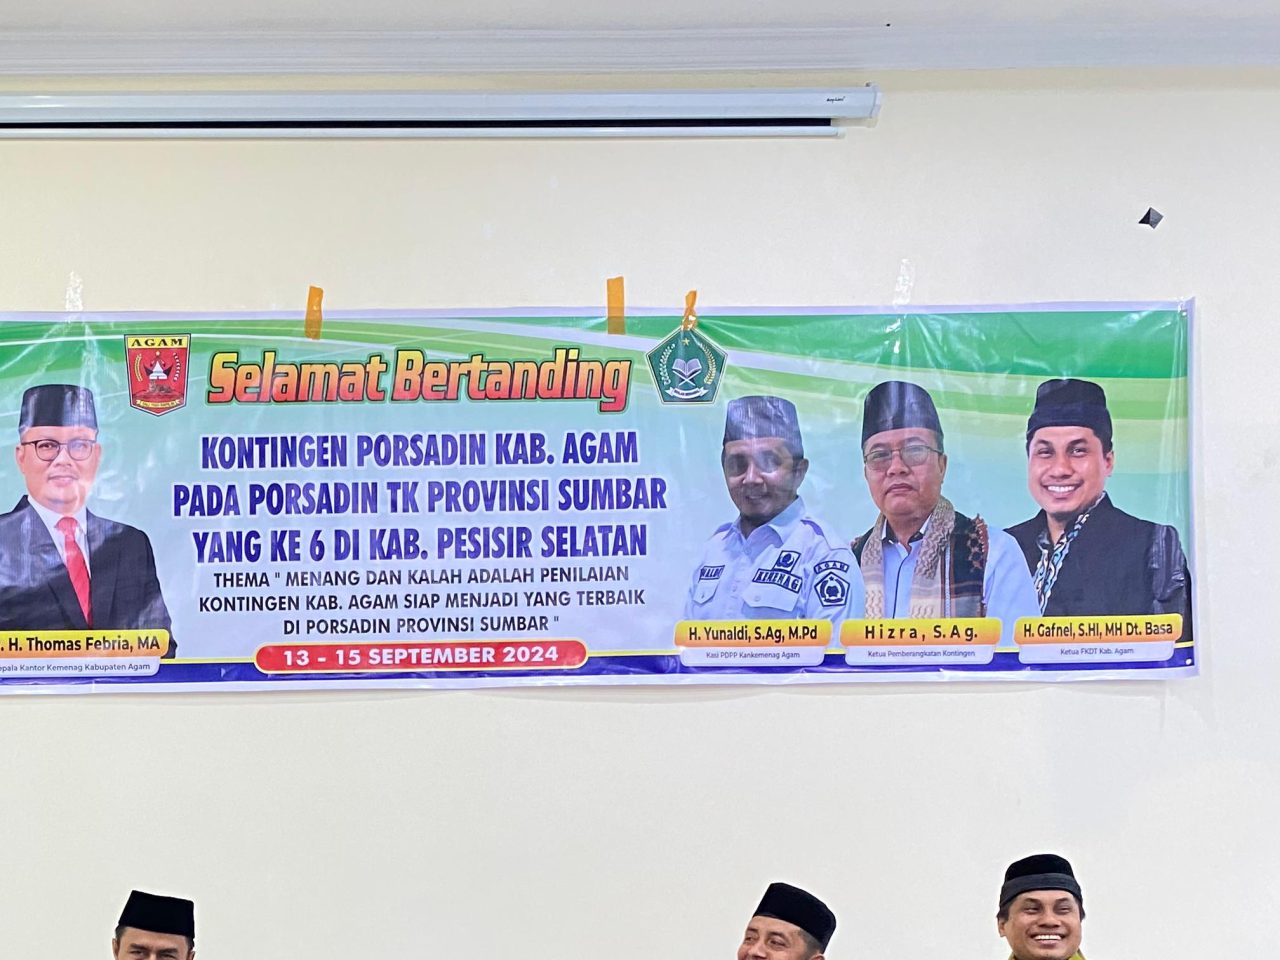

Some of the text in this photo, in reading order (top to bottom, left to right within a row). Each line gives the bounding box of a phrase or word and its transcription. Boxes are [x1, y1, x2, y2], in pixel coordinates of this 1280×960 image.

[131, 339, 183, 347] AGAM
[207, 347, 632, 414] Selamat Bertanding
[202, 431, 638, 469] KONTINGEN PORSADIN KAB. AGAM
[174, 478, 667, 517] PADA PORSADIN TK PROVINSI SUMBAR
[193, 525, 647, 563] YANG KE 6 DI KAB. PESISIR SELATAN
[214, 572, 269, 588] THEMA
[286, 571, 360, 587] MENANG
[367, 570, 401, 585] DAN
[408, 569, 461, 584] KALAH
[468, 568, 534, 584] ADALAH
[540, 566, 628, 582] PENILAIAN
[200, 590, 645, 612] KONTINGEN KAB. AGAM SIAP MENJADI YANG TERBAIK
[284, 620, 300, 635] DI
[307, 618, 390, 634] PORSADIN
[397, 618, 474, 632] PROVINSI
[480, 616, 548, 632] SUMBAR
[689, 626, 817, 643] H. Yunaldi, S.Ag, M.Pd
[1024, 622, 1172, 639] H. Gafnel, S.HI, MH Dt. Basa
[9, 638, 22, 651] H.
[26, 637, 81, 650] Thomas
[86, 636, 133, 652] Febria,
[138, 636, 160, 649] MA
[284, 651, 309, 666] 13
[336, 650, 360, 665] 15
[368, 648, 495, 664] SEPTEMBER
[503, 646, 558, 662] 2024
[888, 650, 941, 658] Pemberangkatan
[47, 664, 82, 672] Kemenag
[85, 663, 126, 672] Kabupaten
